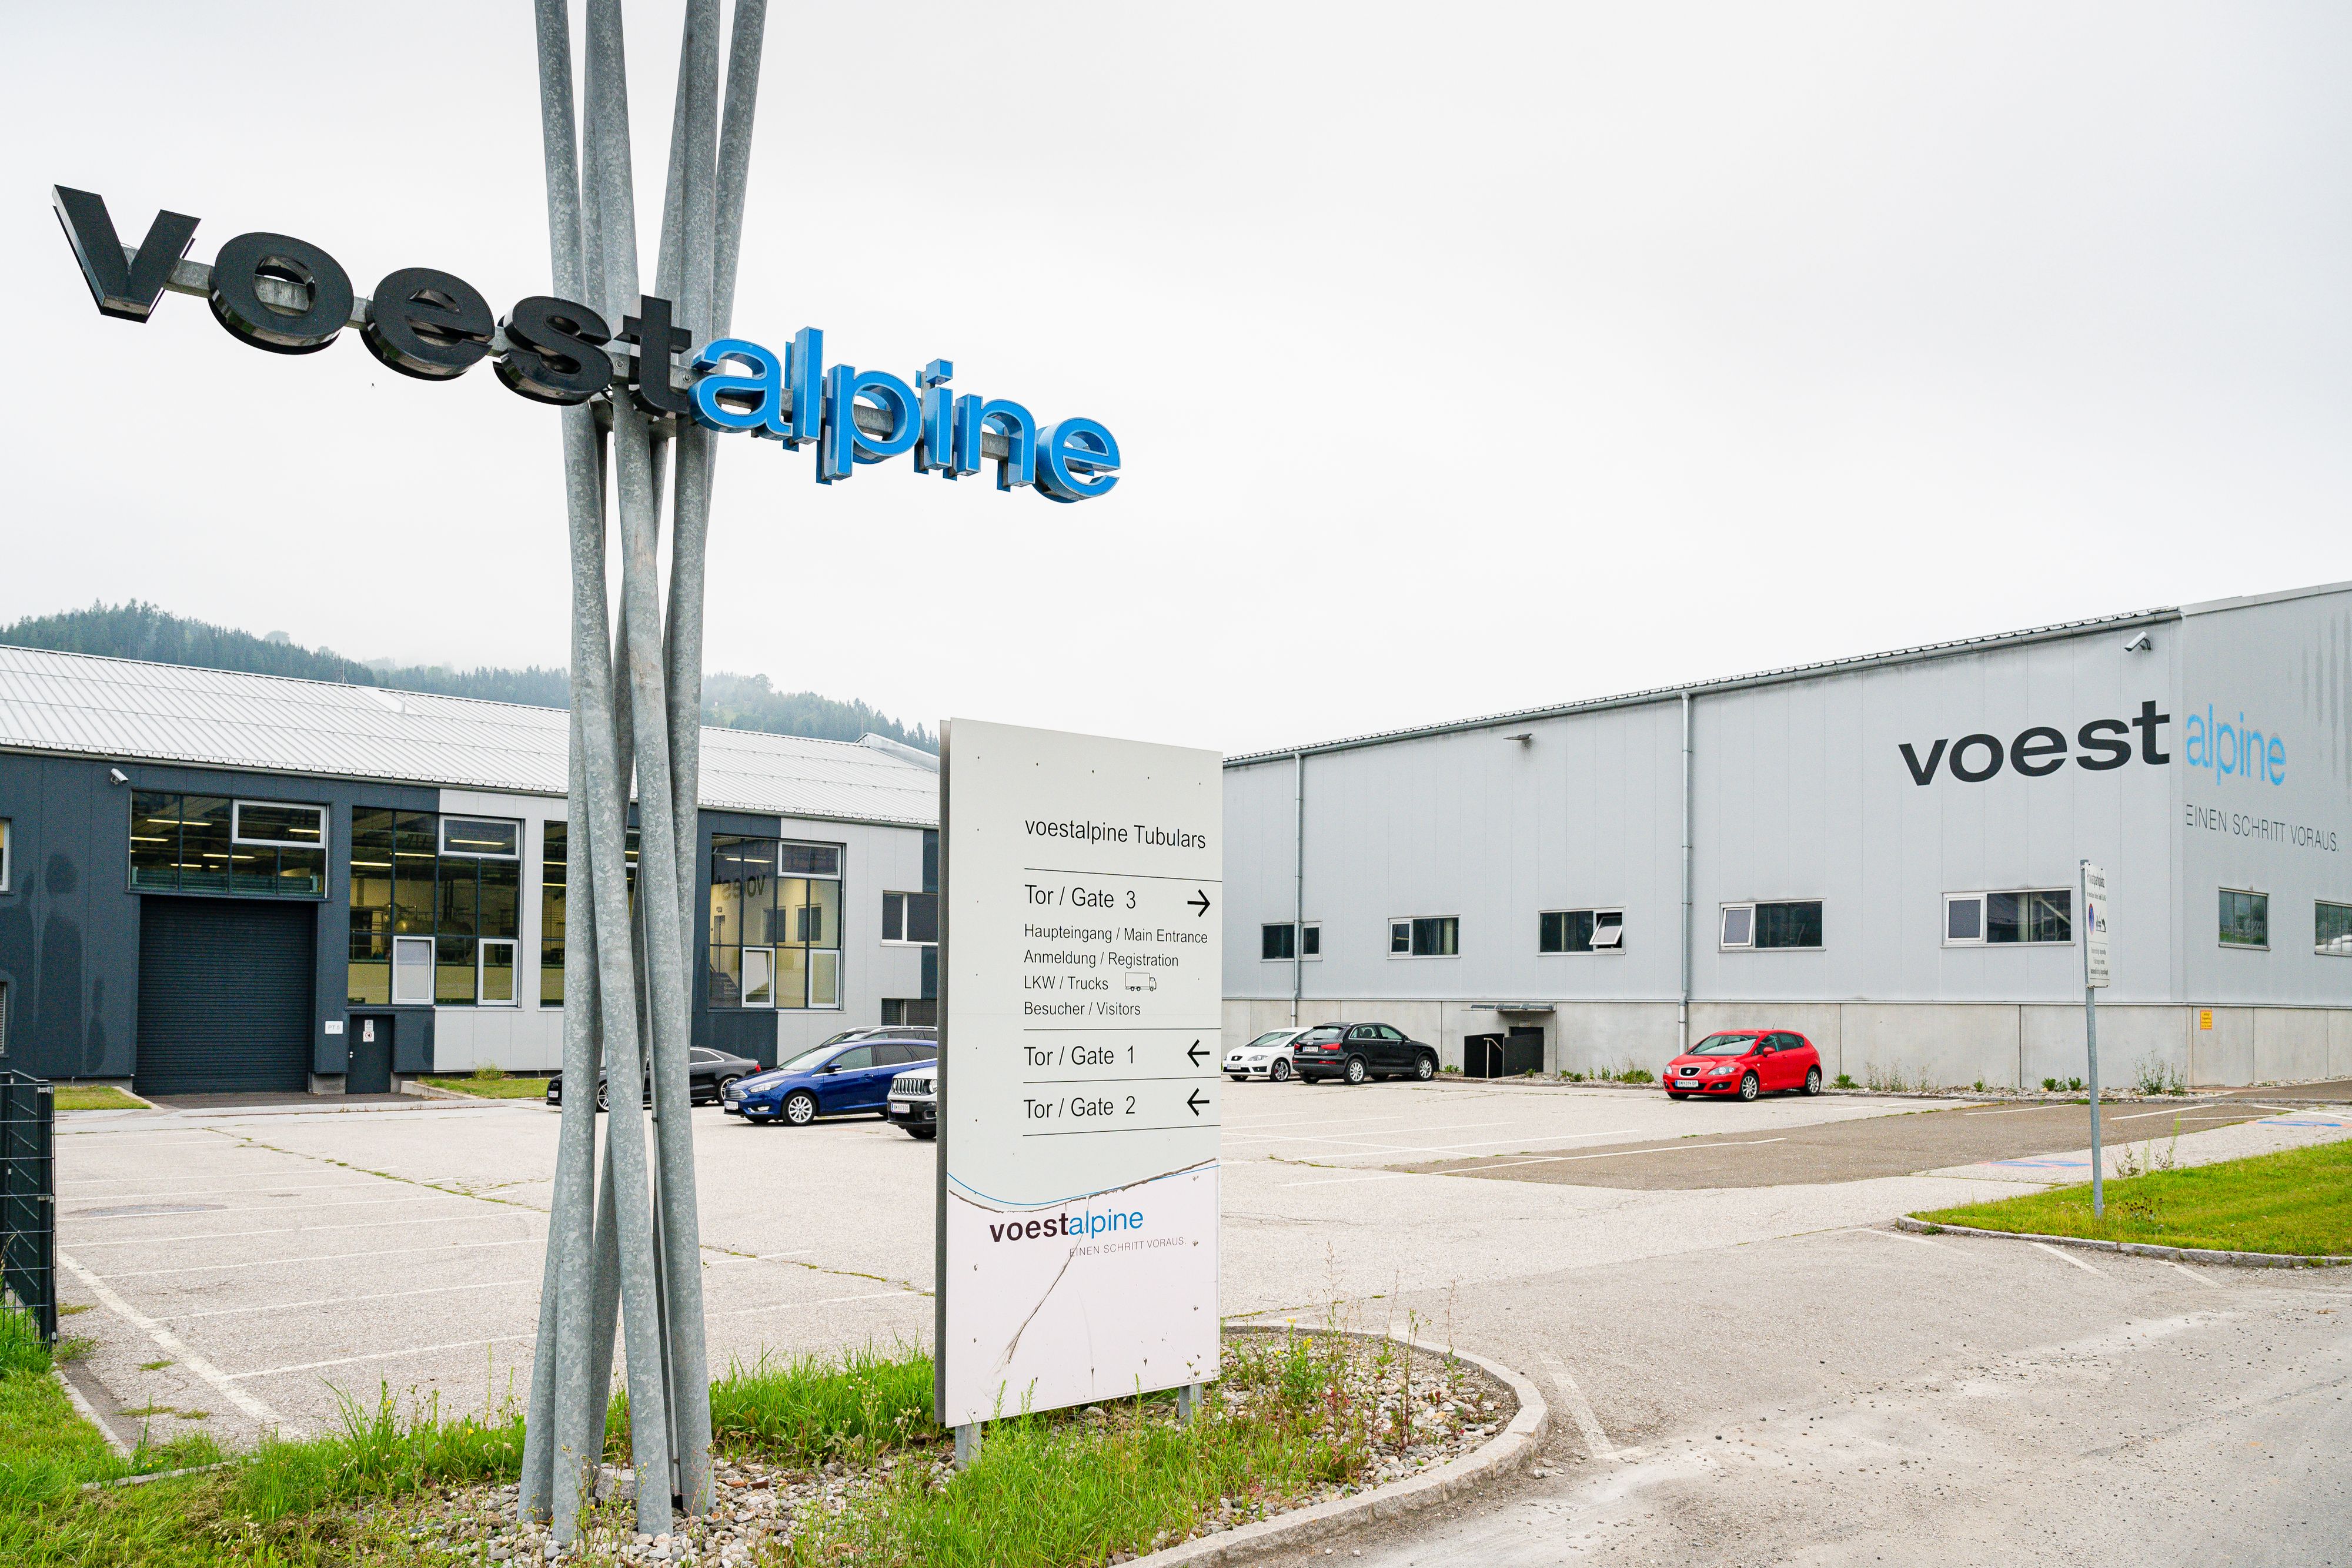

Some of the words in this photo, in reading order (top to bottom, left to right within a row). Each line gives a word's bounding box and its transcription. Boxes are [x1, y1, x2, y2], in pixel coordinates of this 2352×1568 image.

[54, 185, 1121, 503] voestalpine
[1025, 820, 1127, 844] voestalpine
[1134, 825, 1205, 850] Tubulars
[2186, 804, 2227, 833] EINEN
[2233, 814, 2286, 843] SCHRITT
[2290, 825, 2340, 852] VORAUS.
[1025, 884, 1054, 904] Tor
[1060, 887, 1065, 905] /
[1072, 887, 1114, 908] Gate
[1127, 891, 1135, 909] 3
[1025, 924, 1111, 943] Haupteingang
[1116, 927, 1120, 940] /
[1125, 928, 1152, 941] Main
[1157, 929, 1207, 943] Entrance
[1024, 950, 1095, 968] Anmeldung
[1100, 952, 1104, 964] /
[1109, 952, 1178, 969] Registration
[1025, 975, 1055, 989] LKW
[1060, 976, 1063, 989] /
[1068, 977, 1108, 989] Trucks
[1025, 1002, 1085, 1015] Besucher
[1089, 1002, 1093, 1015] /
[1097, 1002, 1140, 1015] Visitors
[1024, 1047, 1053, 1066] Tor
[1059, 1046, 1064, 1065] /
[1071, 1046, 1114, 1065] Gate
[1128, 1045, 1132, 1064] 1
[1024, 1099, 1053, 1118] Tor
[1058, 1098, 1064, 1118] /
[1071, 1098, 1113, 1116] Gate
[1125, 1096, 1135, 1114] 2
[990, 1208, 1143, 1242] voestalpine
[1069, 1246, 1100, 1257] EINEN
[1104, 1241, 1144, 1253] SCHRITT
[1147, 1237, 1186, 1248] VORAUS.
